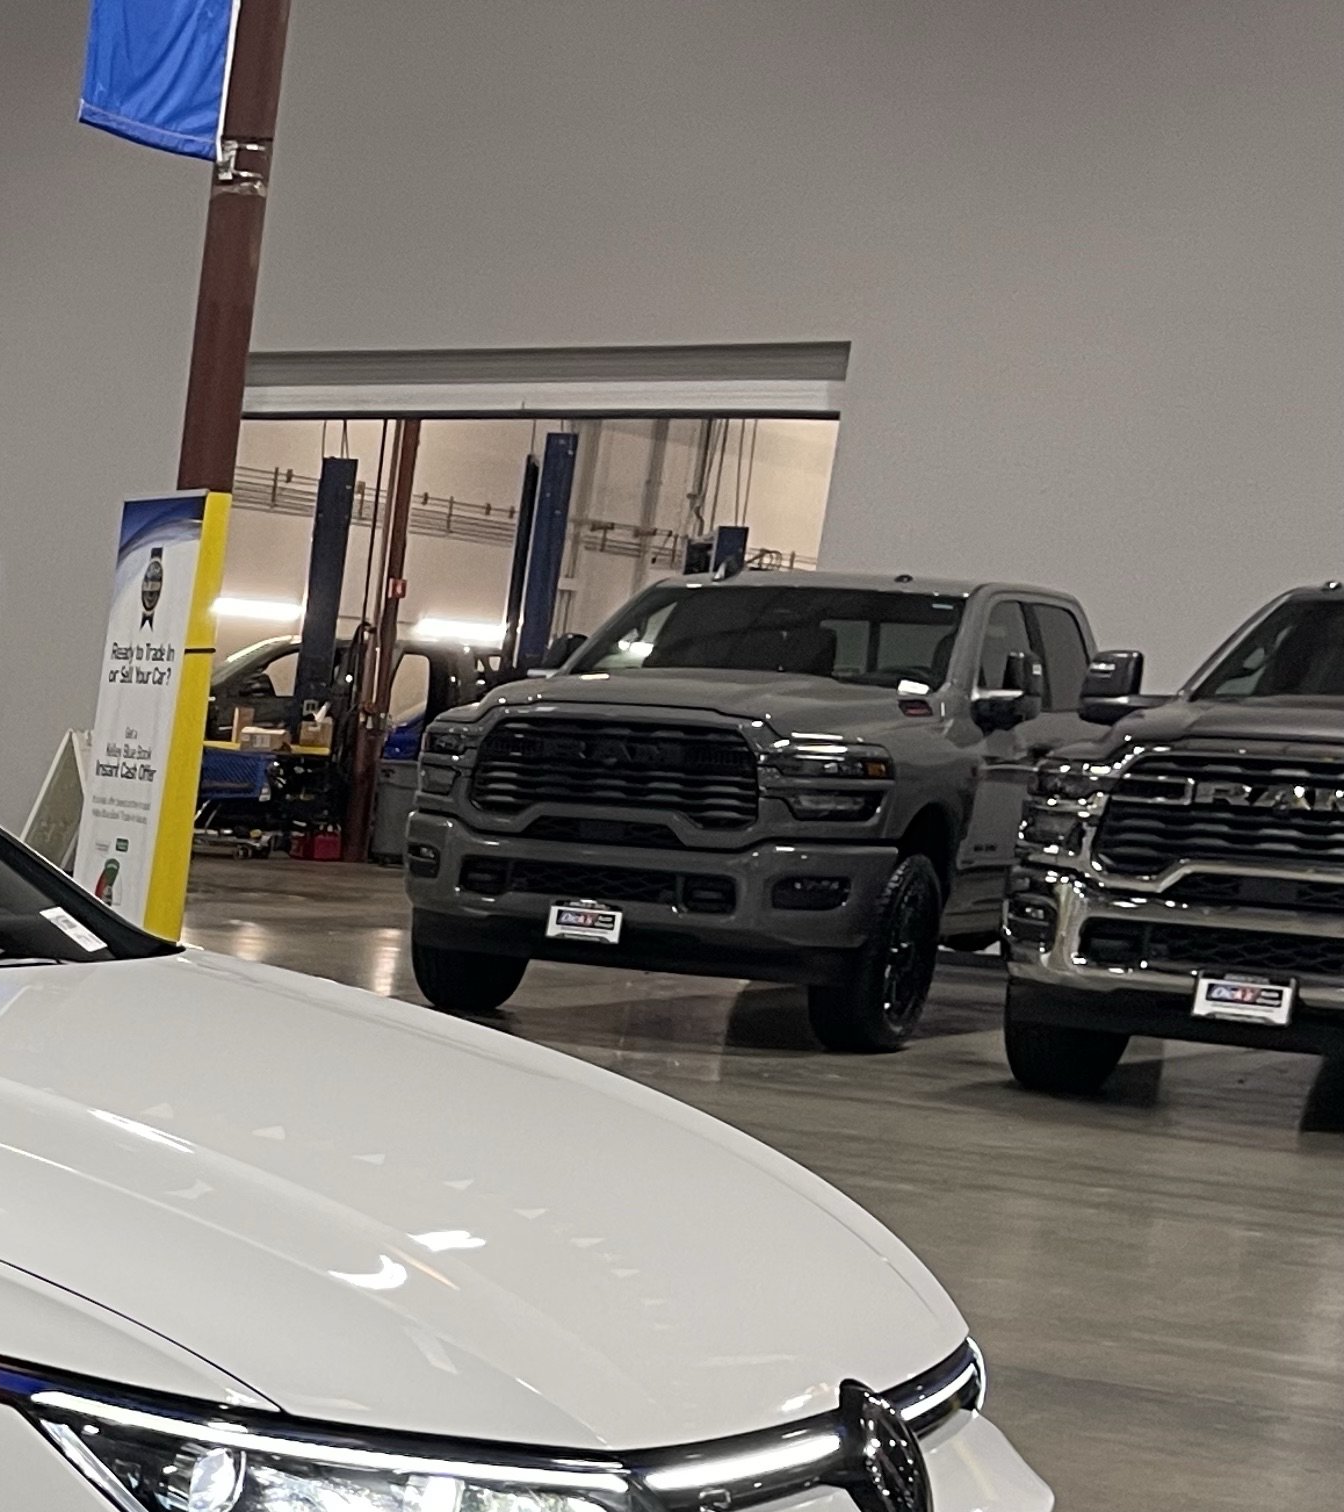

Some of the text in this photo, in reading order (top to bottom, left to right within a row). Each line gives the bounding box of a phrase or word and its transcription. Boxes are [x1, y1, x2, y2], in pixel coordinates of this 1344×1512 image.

[111, 641, 134, 665] Ready
[136, 644, 144, 661] to
[145, 642, 166, 662] Trade
[108, 665, 172, 686] or Sell Your Car?
